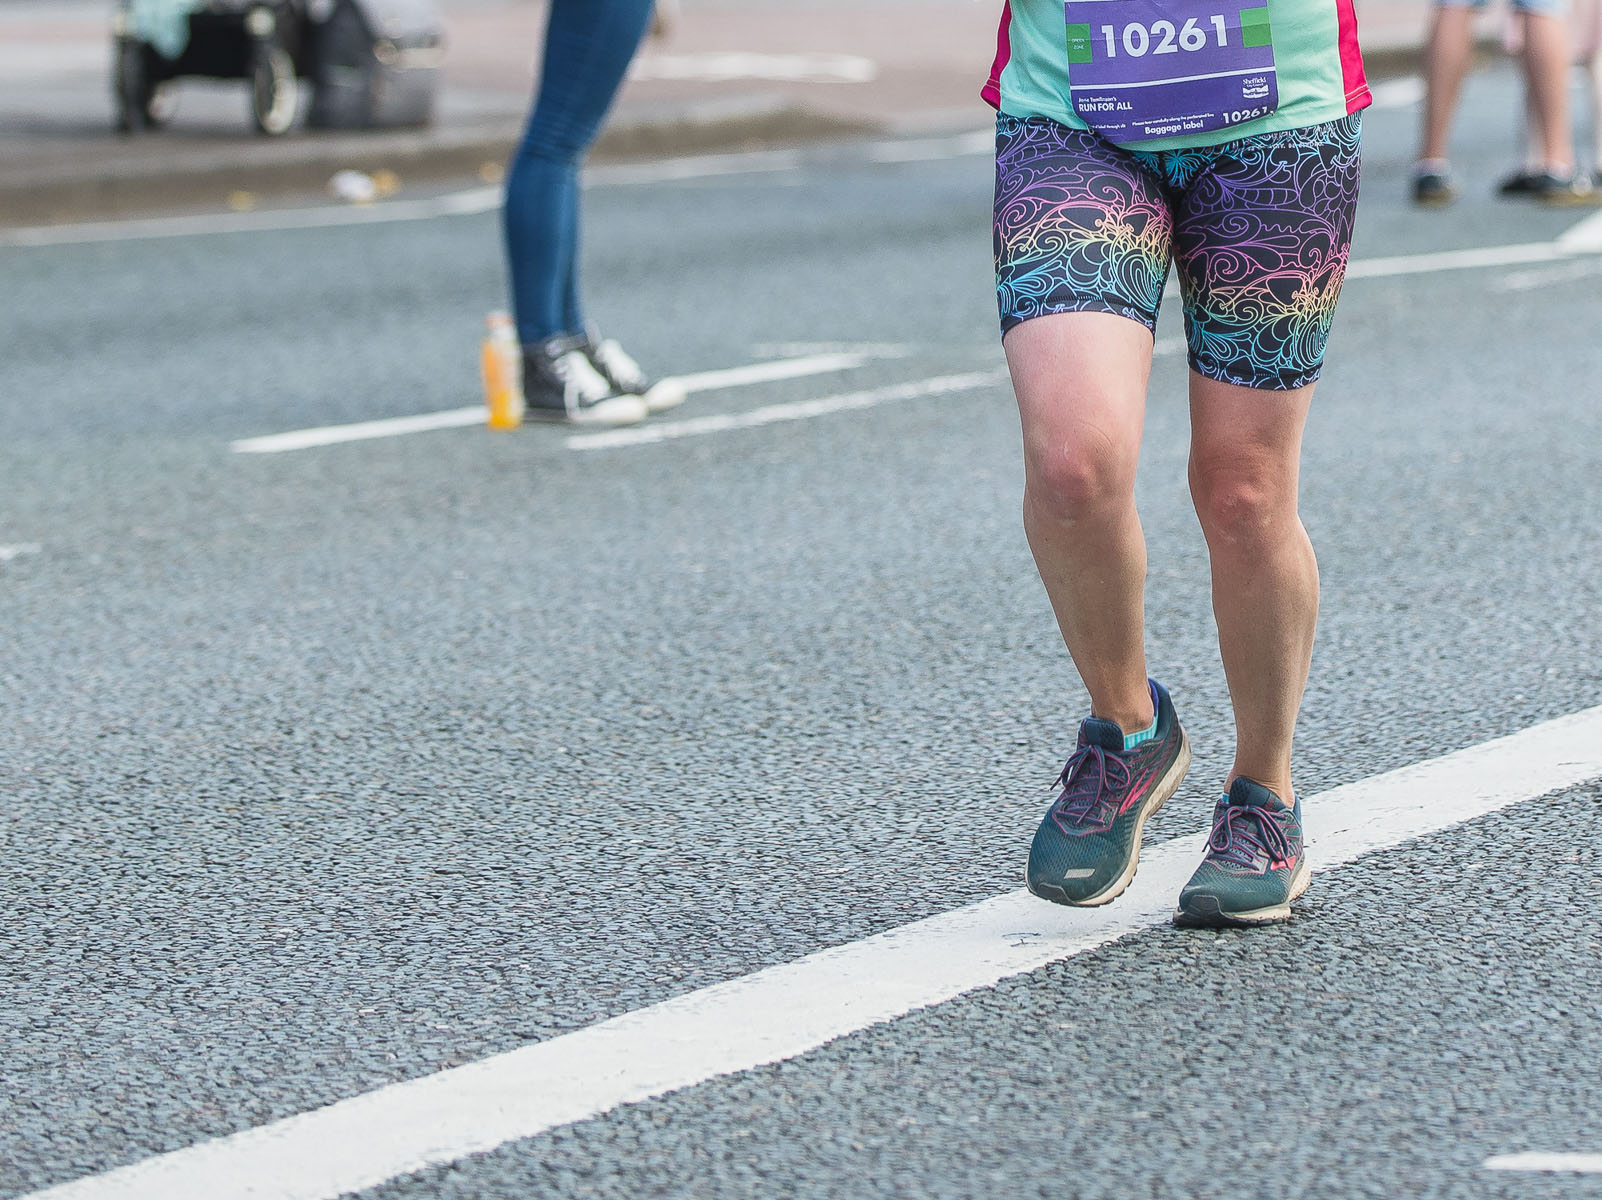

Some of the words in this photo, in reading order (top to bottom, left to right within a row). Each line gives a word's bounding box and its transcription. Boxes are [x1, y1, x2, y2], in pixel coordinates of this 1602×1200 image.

[1101, 14, 1228, 58] 10261
[1242, 76, 1267, 86] Sheffield
[1078, 103, 1097, 112] RUN
[1097, 103, 1115, 112] FOR
[1116, 101, 1133, 110] ALL
[1144, 124, 1182, 135] Baggage
[1182, 119, 1204, 130] label
